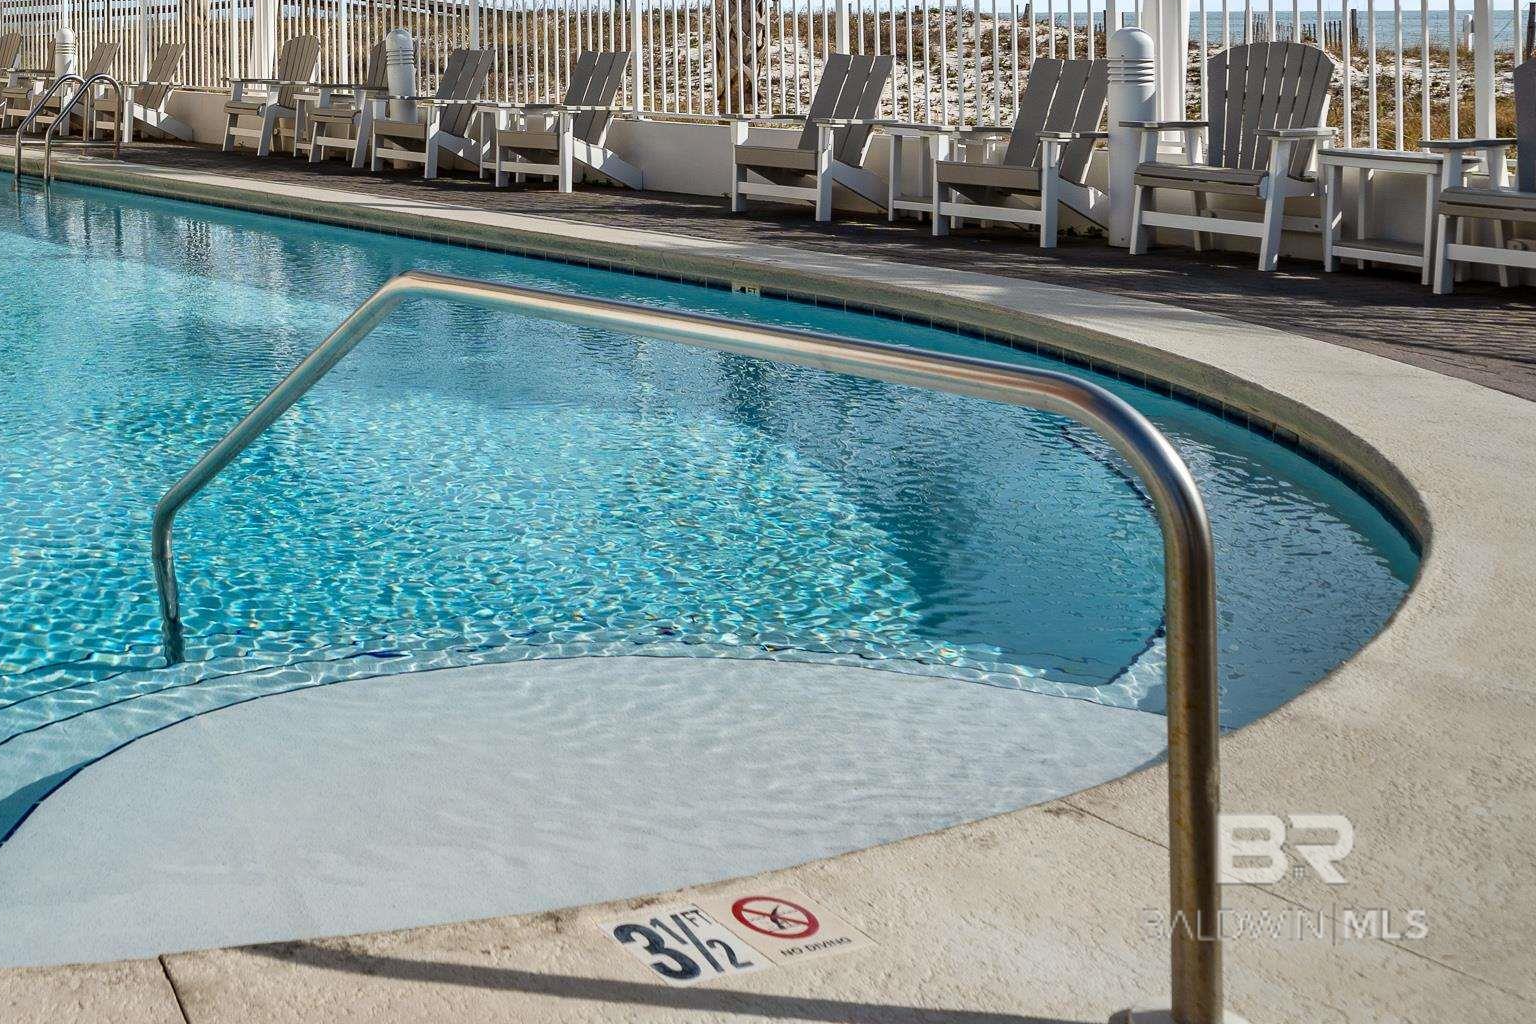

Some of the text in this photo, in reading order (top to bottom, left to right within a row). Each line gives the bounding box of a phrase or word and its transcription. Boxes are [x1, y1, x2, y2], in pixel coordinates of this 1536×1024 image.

[680, 909, 712, 927] FT
[780, 937, 853, 957] NO DIVING
